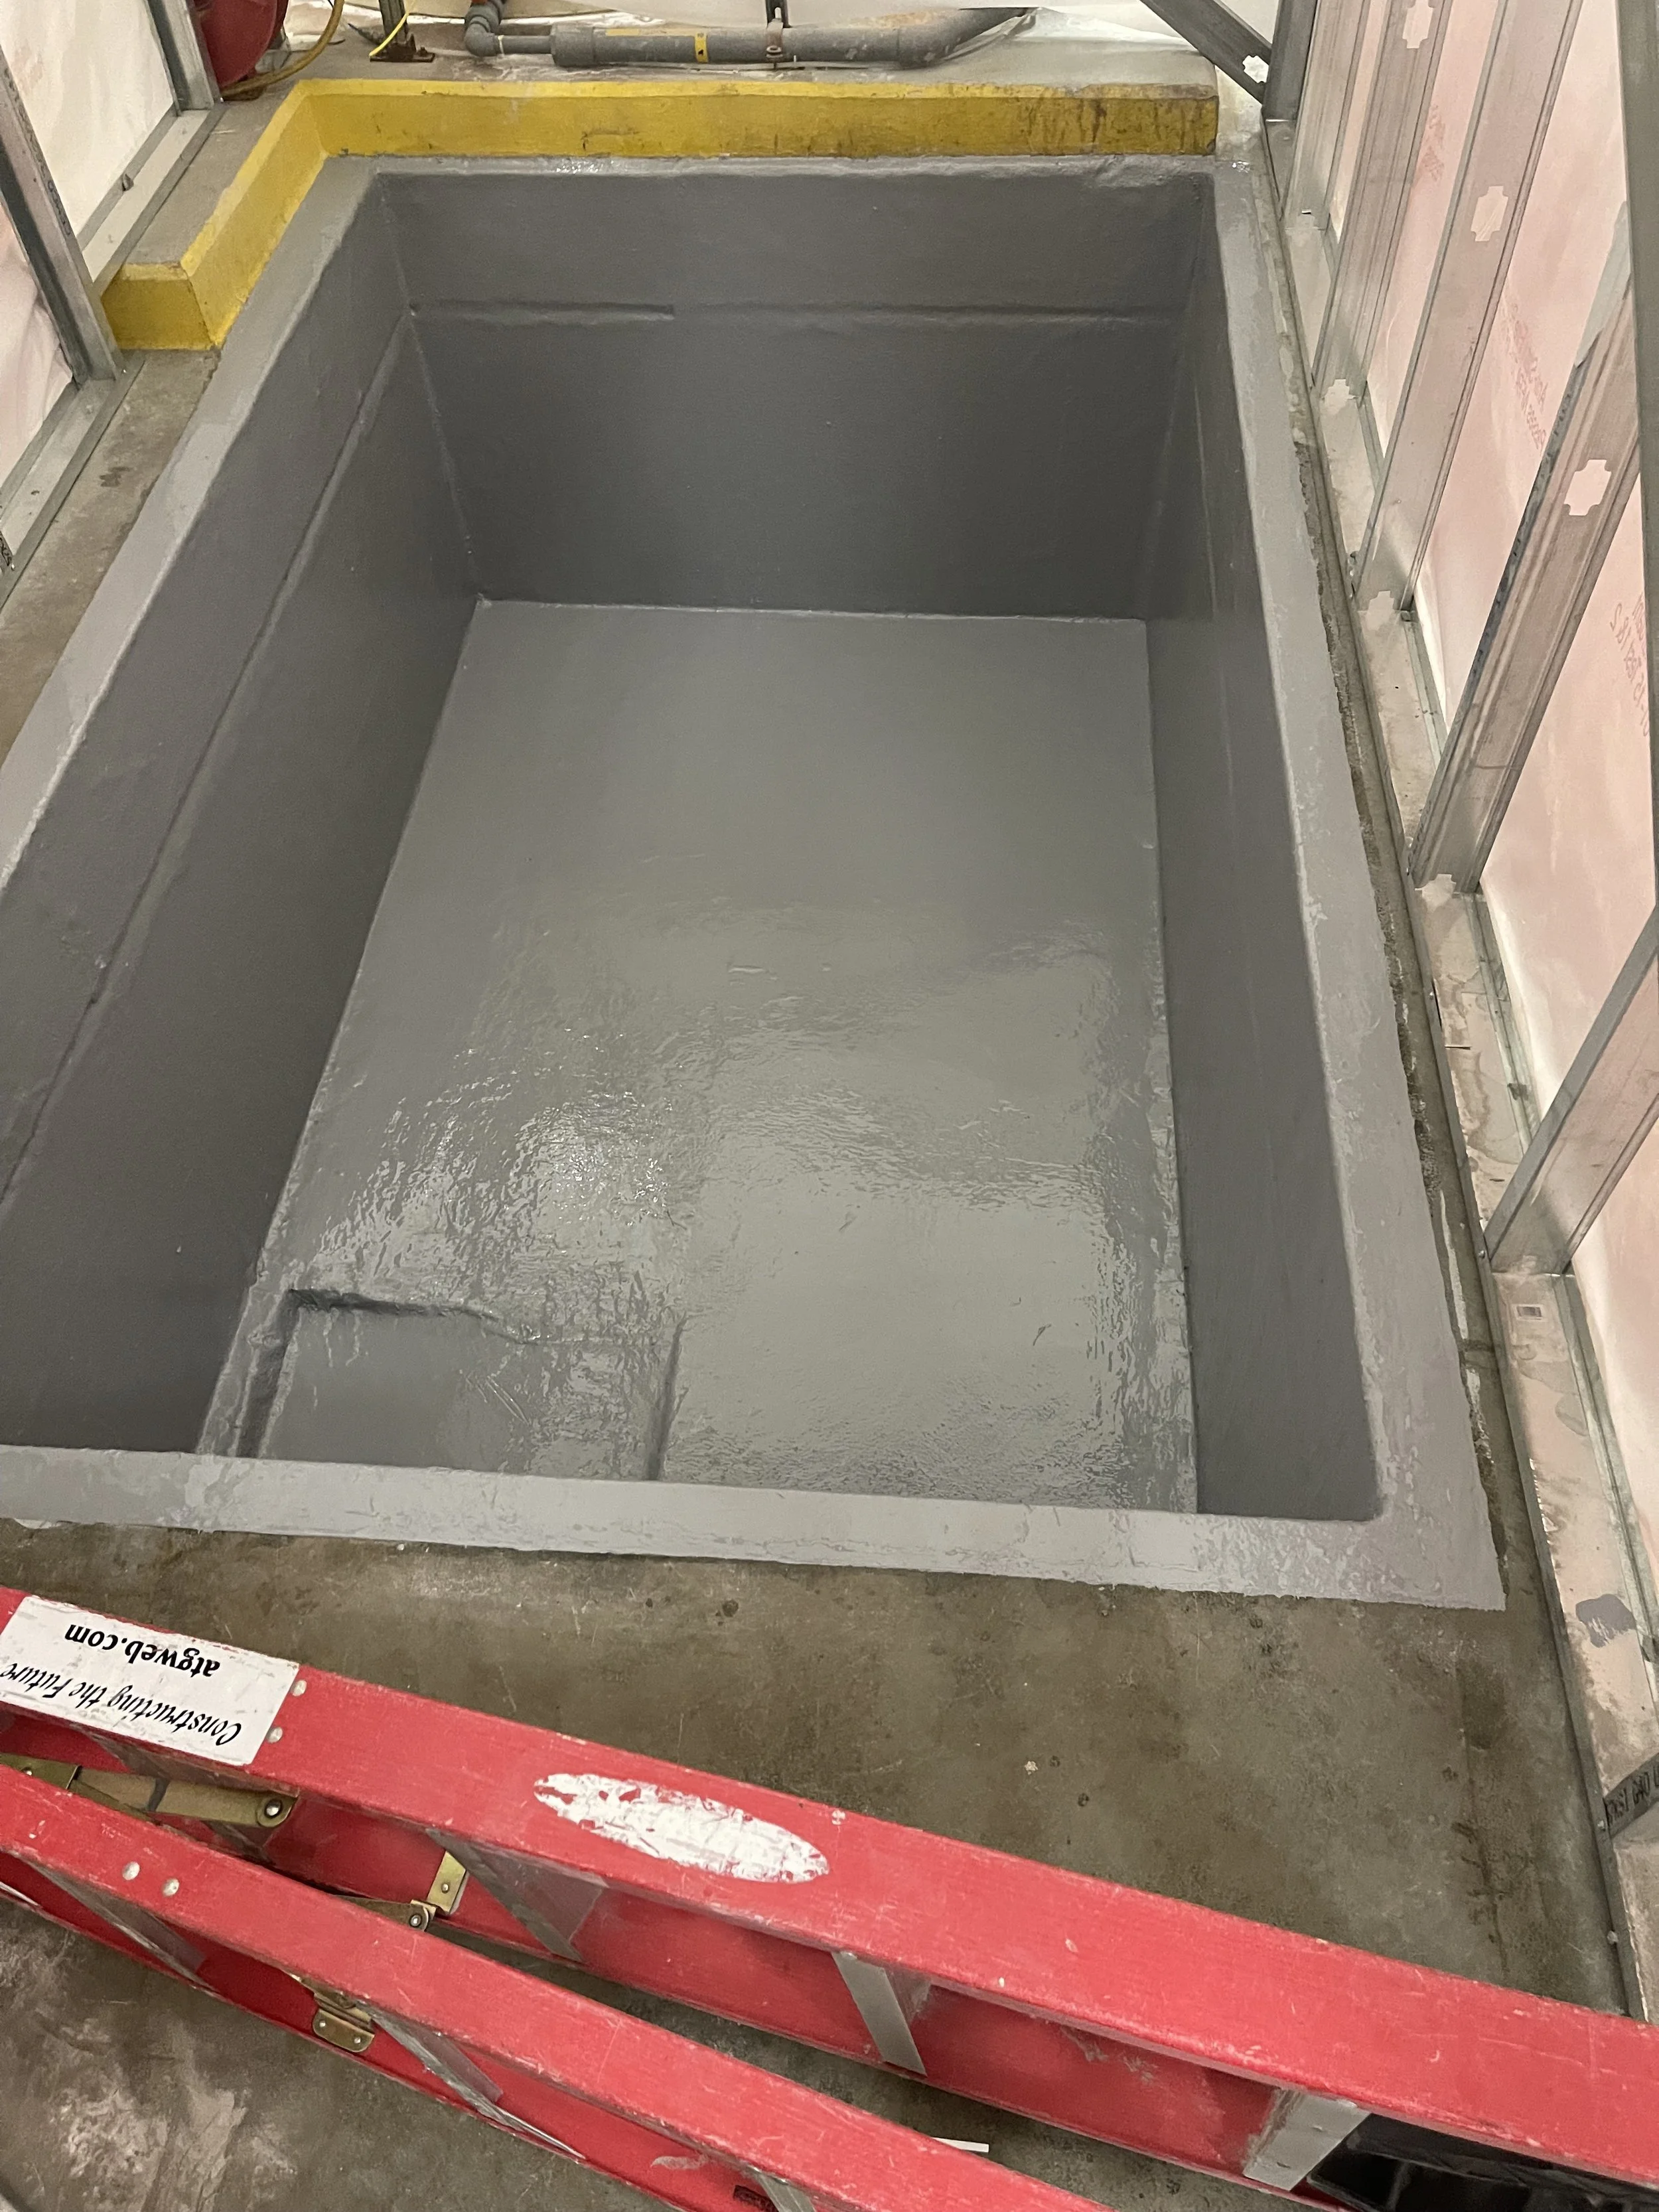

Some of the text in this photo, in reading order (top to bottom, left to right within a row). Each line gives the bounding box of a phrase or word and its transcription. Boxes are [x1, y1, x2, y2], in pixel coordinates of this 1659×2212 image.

[64, 1624, 221, 1678] atgweb.com
[0, 1662, 242, 1746] Constructing the Future
